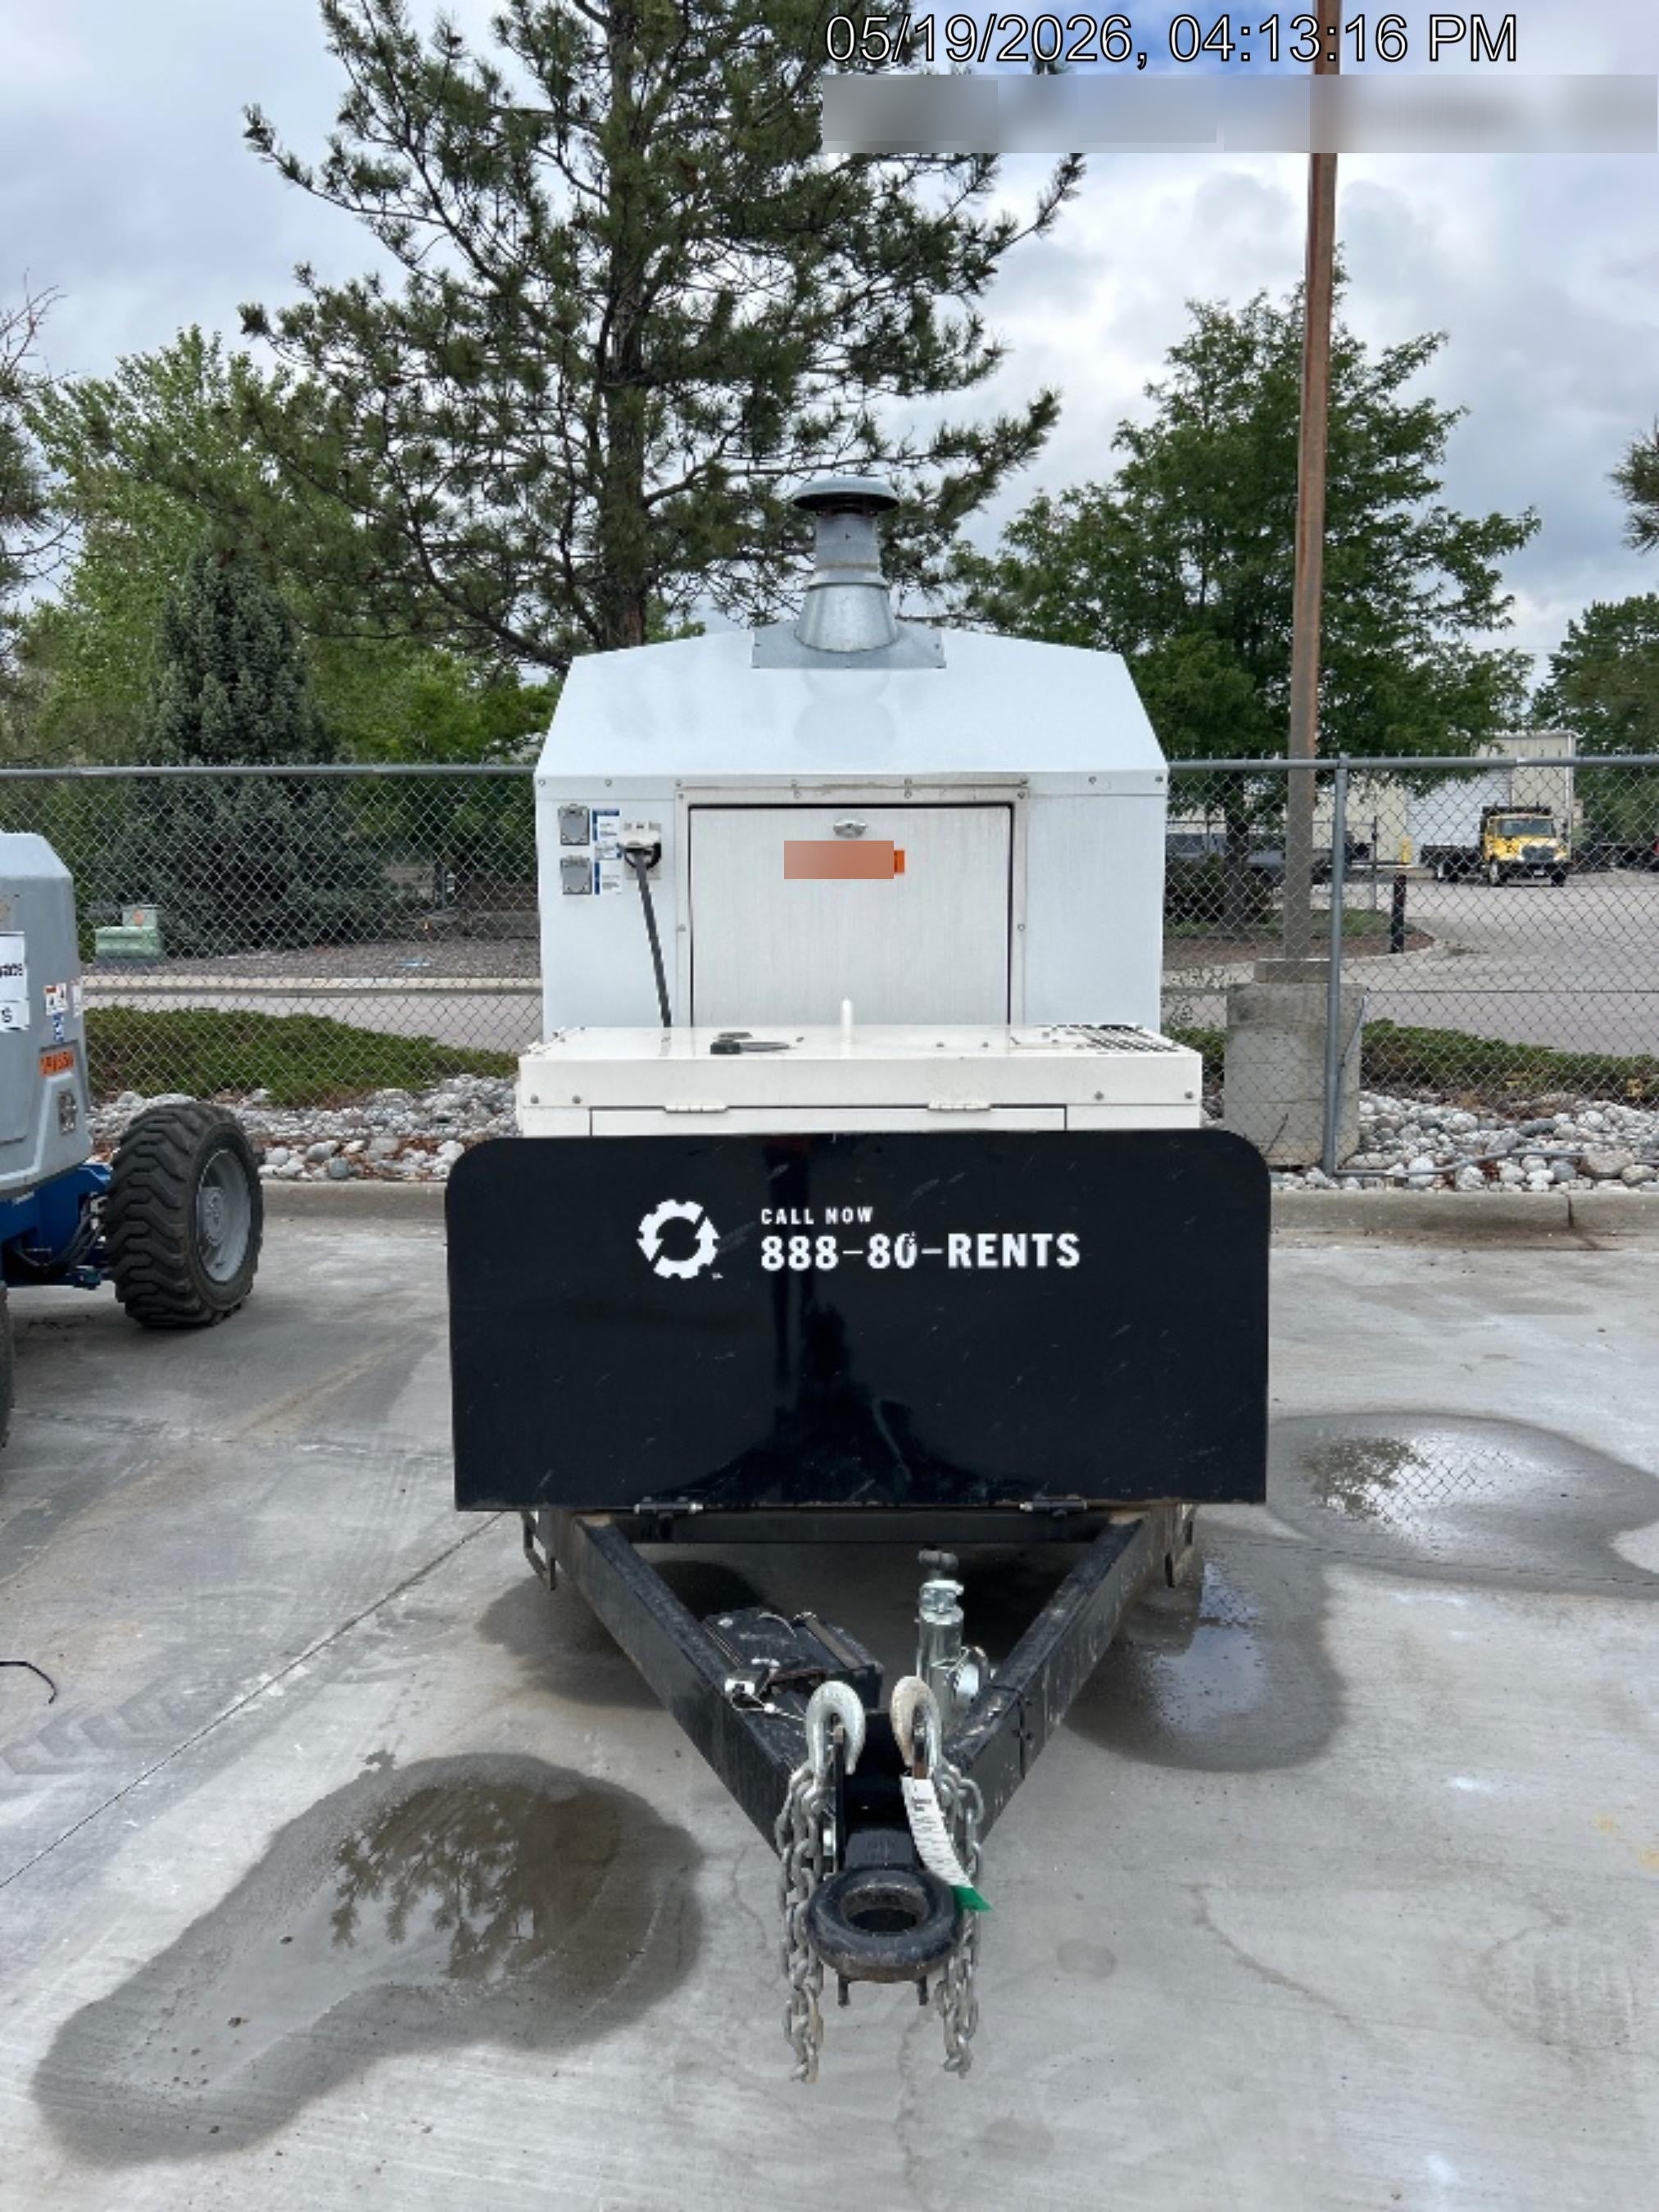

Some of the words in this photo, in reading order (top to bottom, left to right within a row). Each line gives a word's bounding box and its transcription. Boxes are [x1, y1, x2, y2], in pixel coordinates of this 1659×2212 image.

[761, 1207, 815, 1225] CALL
[825, 1207, 873, 1224] NOW
[761, 1232, 1081, 1271] 888-80-RENTS
